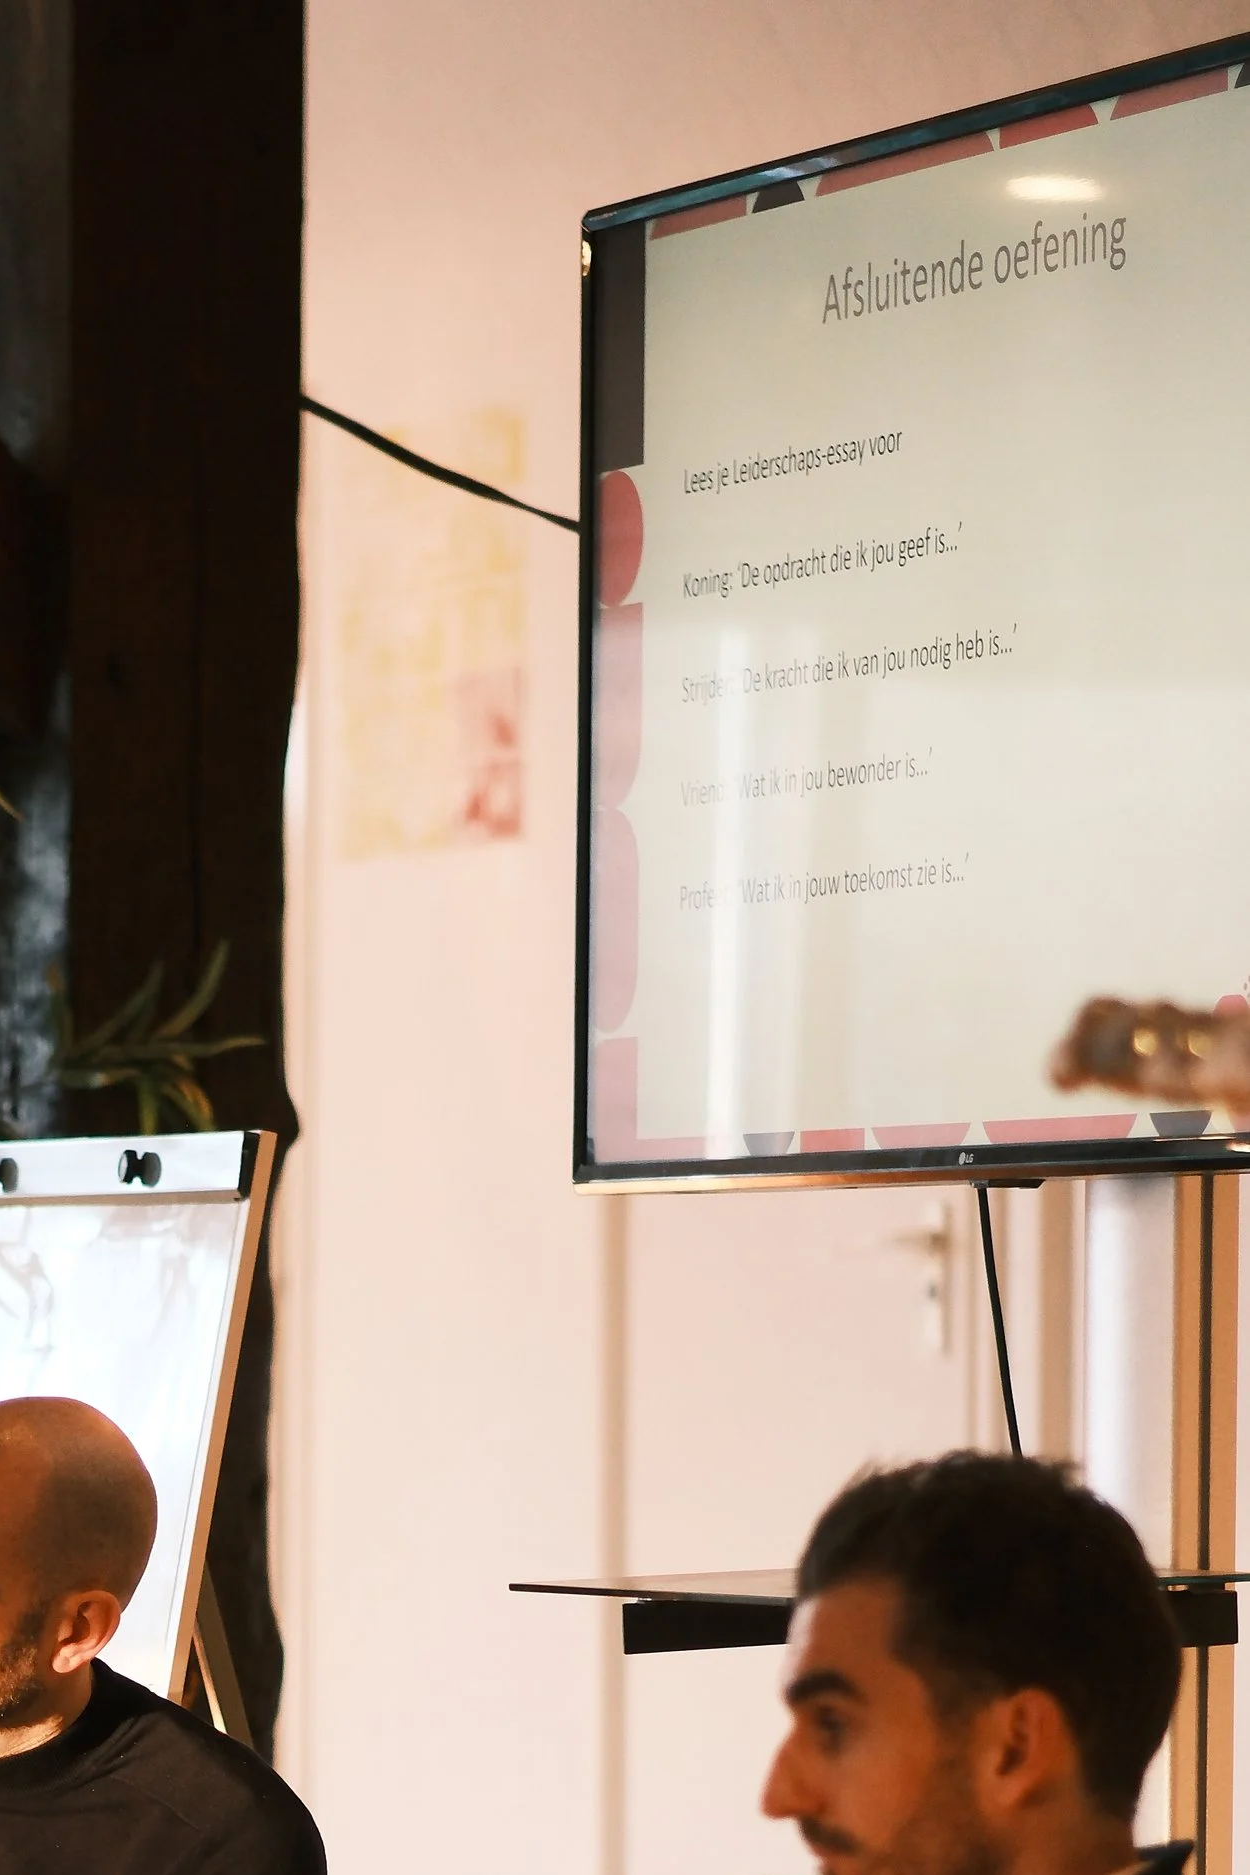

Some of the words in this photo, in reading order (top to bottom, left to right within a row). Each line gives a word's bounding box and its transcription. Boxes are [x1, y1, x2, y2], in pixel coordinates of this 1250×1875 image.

[822, 239, 983, 324] Afsluitende
[994, 212, 1127, 283] oefening
[684, 469, 713, 494] Lees
[717, 462, 730, 495] je
[733, 439, 866, 484] Leiderschaps-essay
[869, 431, 903, 457] voor
[683, 569, 733, 599] Koning:
[763, 548, 827, 589] opdracht
[830, 544, 852, 572] die
[855, 540, 868, 568] ik
[870, 539, 894, 572] jou
[898, 527, 932, 567] geef
[765, 658, 809, 689] kracht
[812, 655, 834, 683] die
[837, 651, 850, 679] ik
[853, 653, 879, 677] van
[882, 646, 905, 678] jou
[910, 636, 951, 670] nodig
[955, 630, 984, 661] heb
[769, 765, 781, 795] ik
[784, 767, 797, 793] in
[800, 765, 823, 798] jou
[827, 753, 902, 788] bewonder
[773, 873, 785, 901] ik
[788, 873, 801, 899] in
[804, 872, 840, 904] jouw
[844, 863, 913, 894] toekomst
[917, 858, 937, 886] zie
